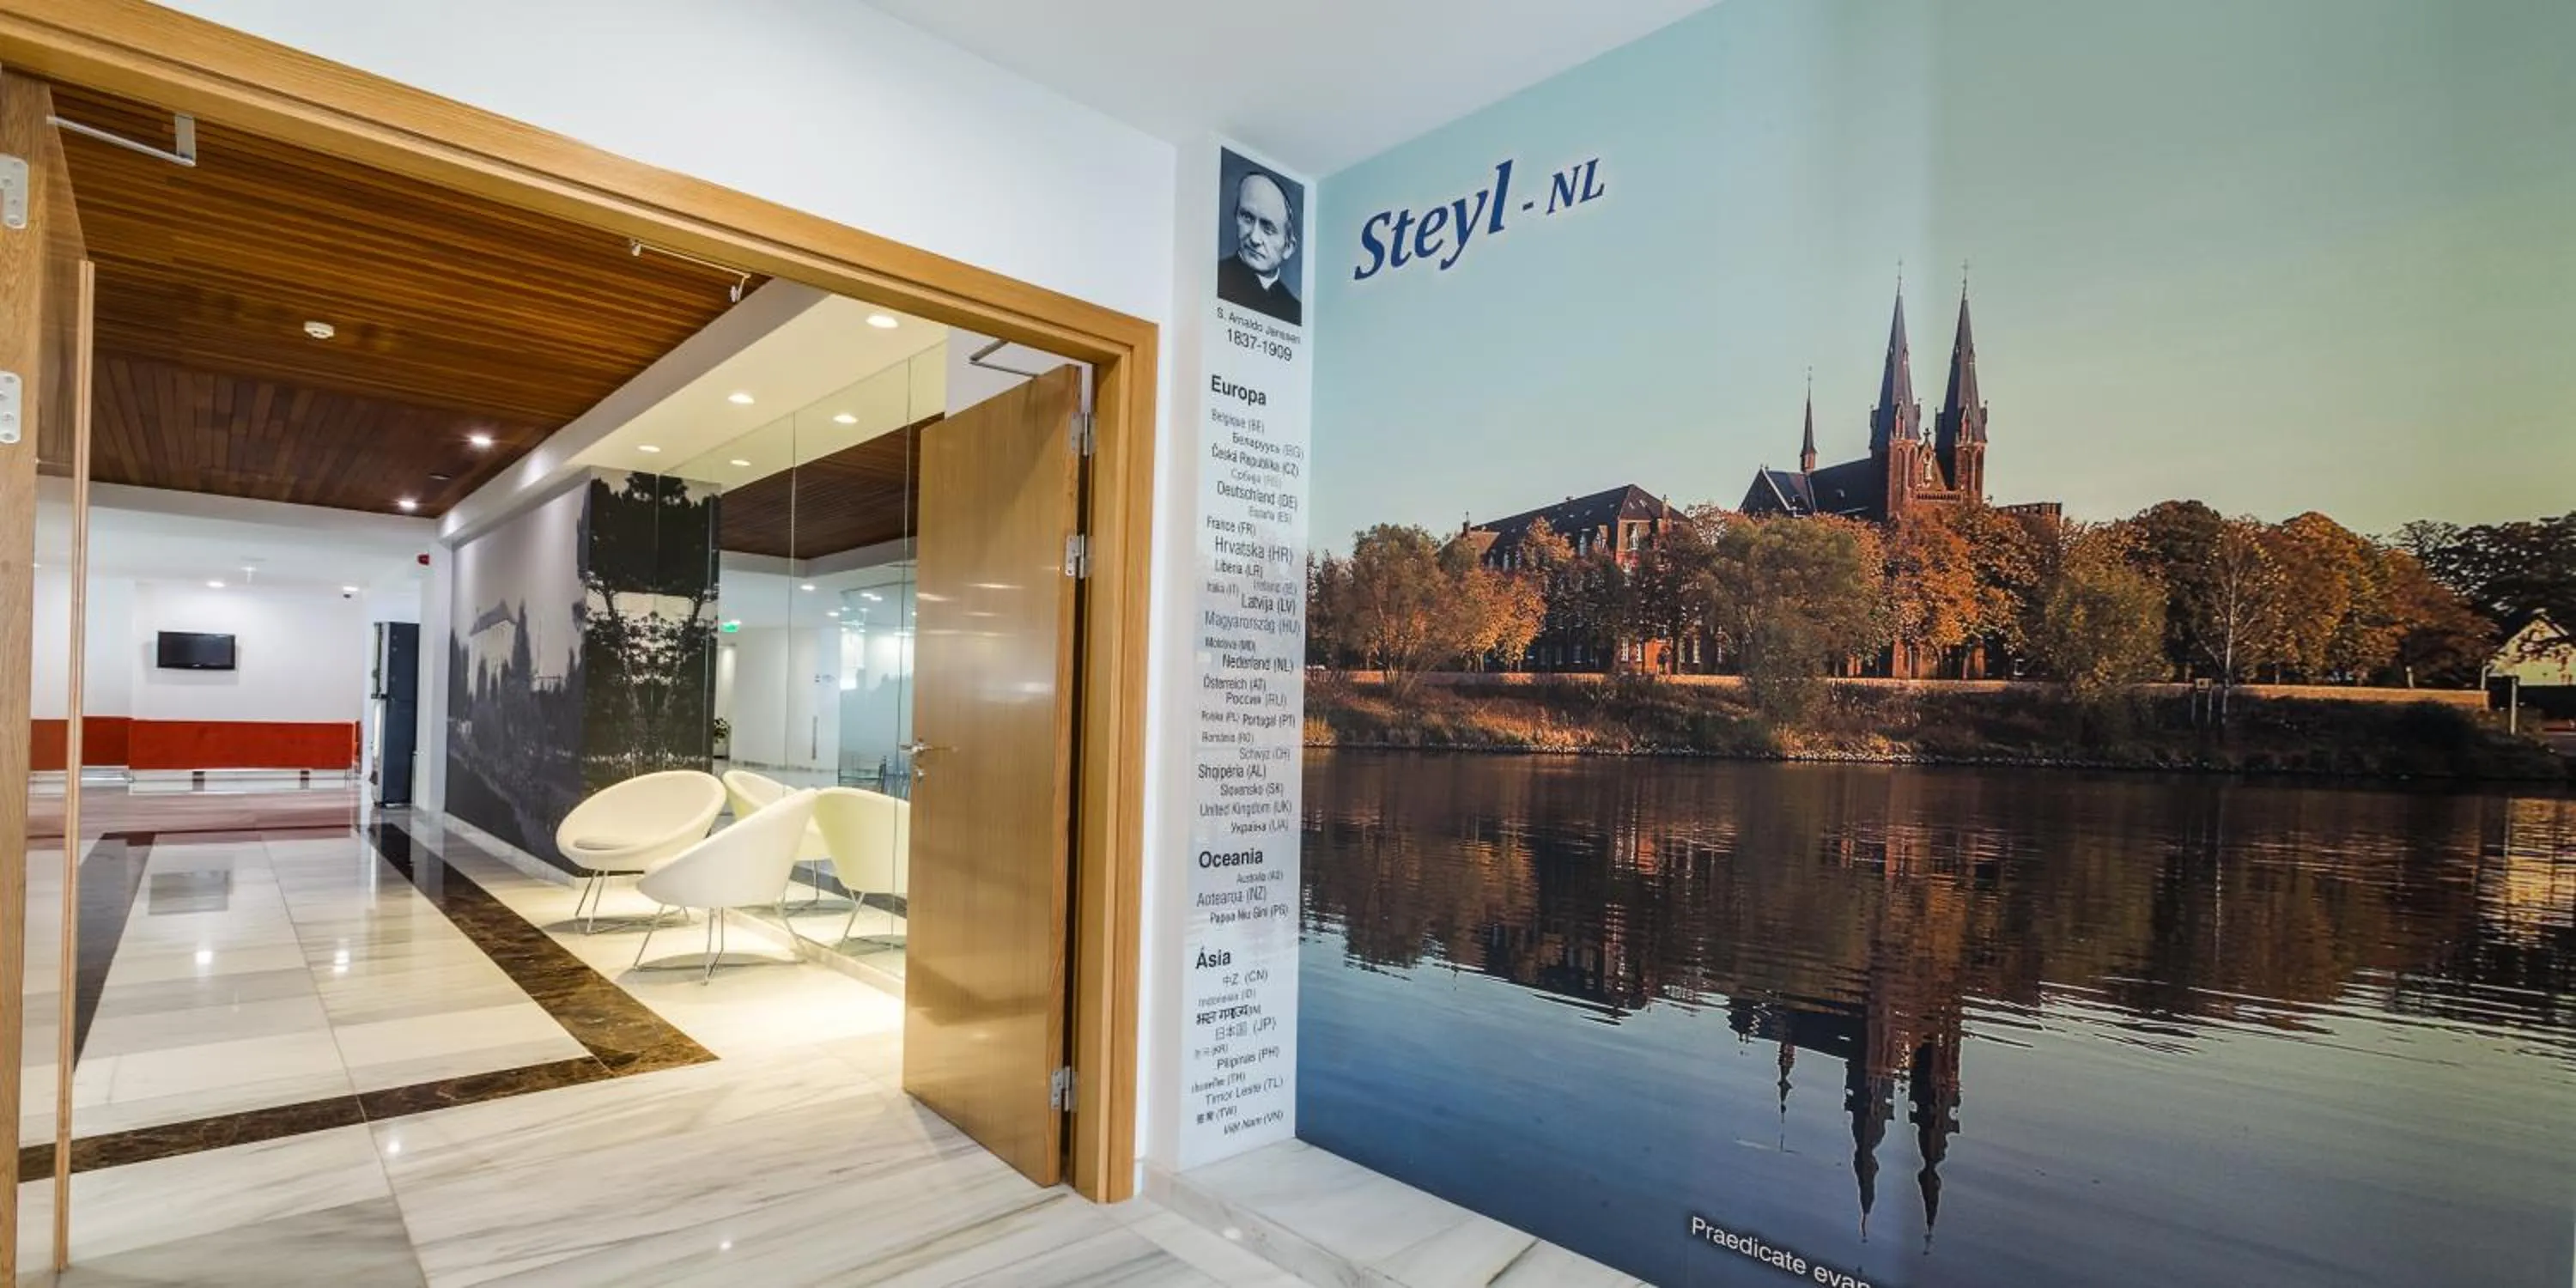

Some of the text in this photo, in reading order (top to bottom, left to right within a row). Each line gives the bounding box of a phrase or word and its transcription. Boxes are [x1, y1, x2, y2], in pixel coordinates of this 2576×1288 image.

[1354, 159, 1513, 280] Steyl
[1546, 158, 1605, 215] NL
[1229, 312, 1263, 332] Arnaldo
[1227, 328, 1293, 361] 1837-1909
[1211, 374, 1267, 406] Europa
[1217, 480, 1274, 505] Deutschland
[1206, 515, 1235, 532] France
[1215, 535, 1294, 567] Hrvatska (HR)
[1241, 593, 1296, 616] Latvija (LV)
[1199, 848, 1263, 868] Oceania
[1195, 945, 1230, 969] Ásia
[1692, 1216, 1807, 1275] Praedicate
